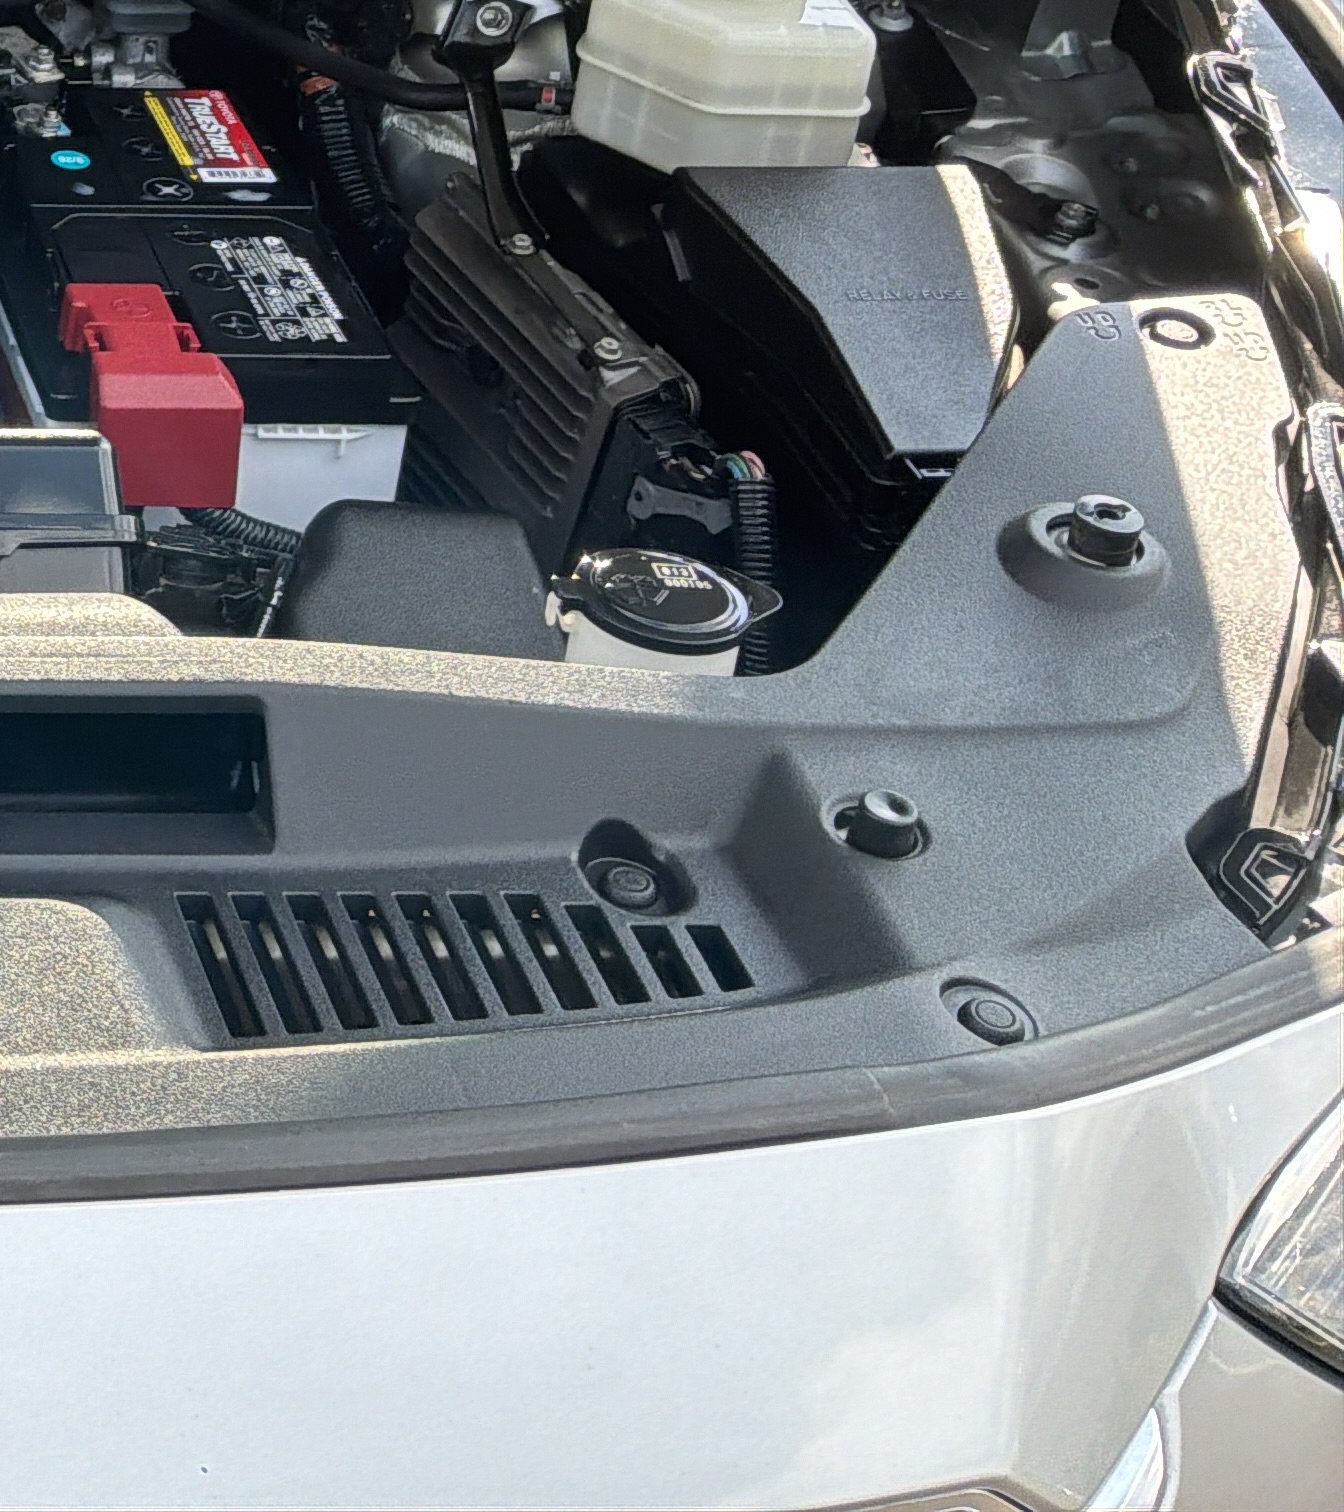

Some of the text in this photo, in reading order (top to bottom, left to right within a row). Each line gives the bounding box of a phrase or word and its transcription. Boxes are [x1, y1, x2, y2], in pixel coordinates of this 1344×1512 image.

[214, 99, 239, 125] TOYOTA
[846, 288, 902, 301] RELAY
[921, 289, 968, 301] FUSE
